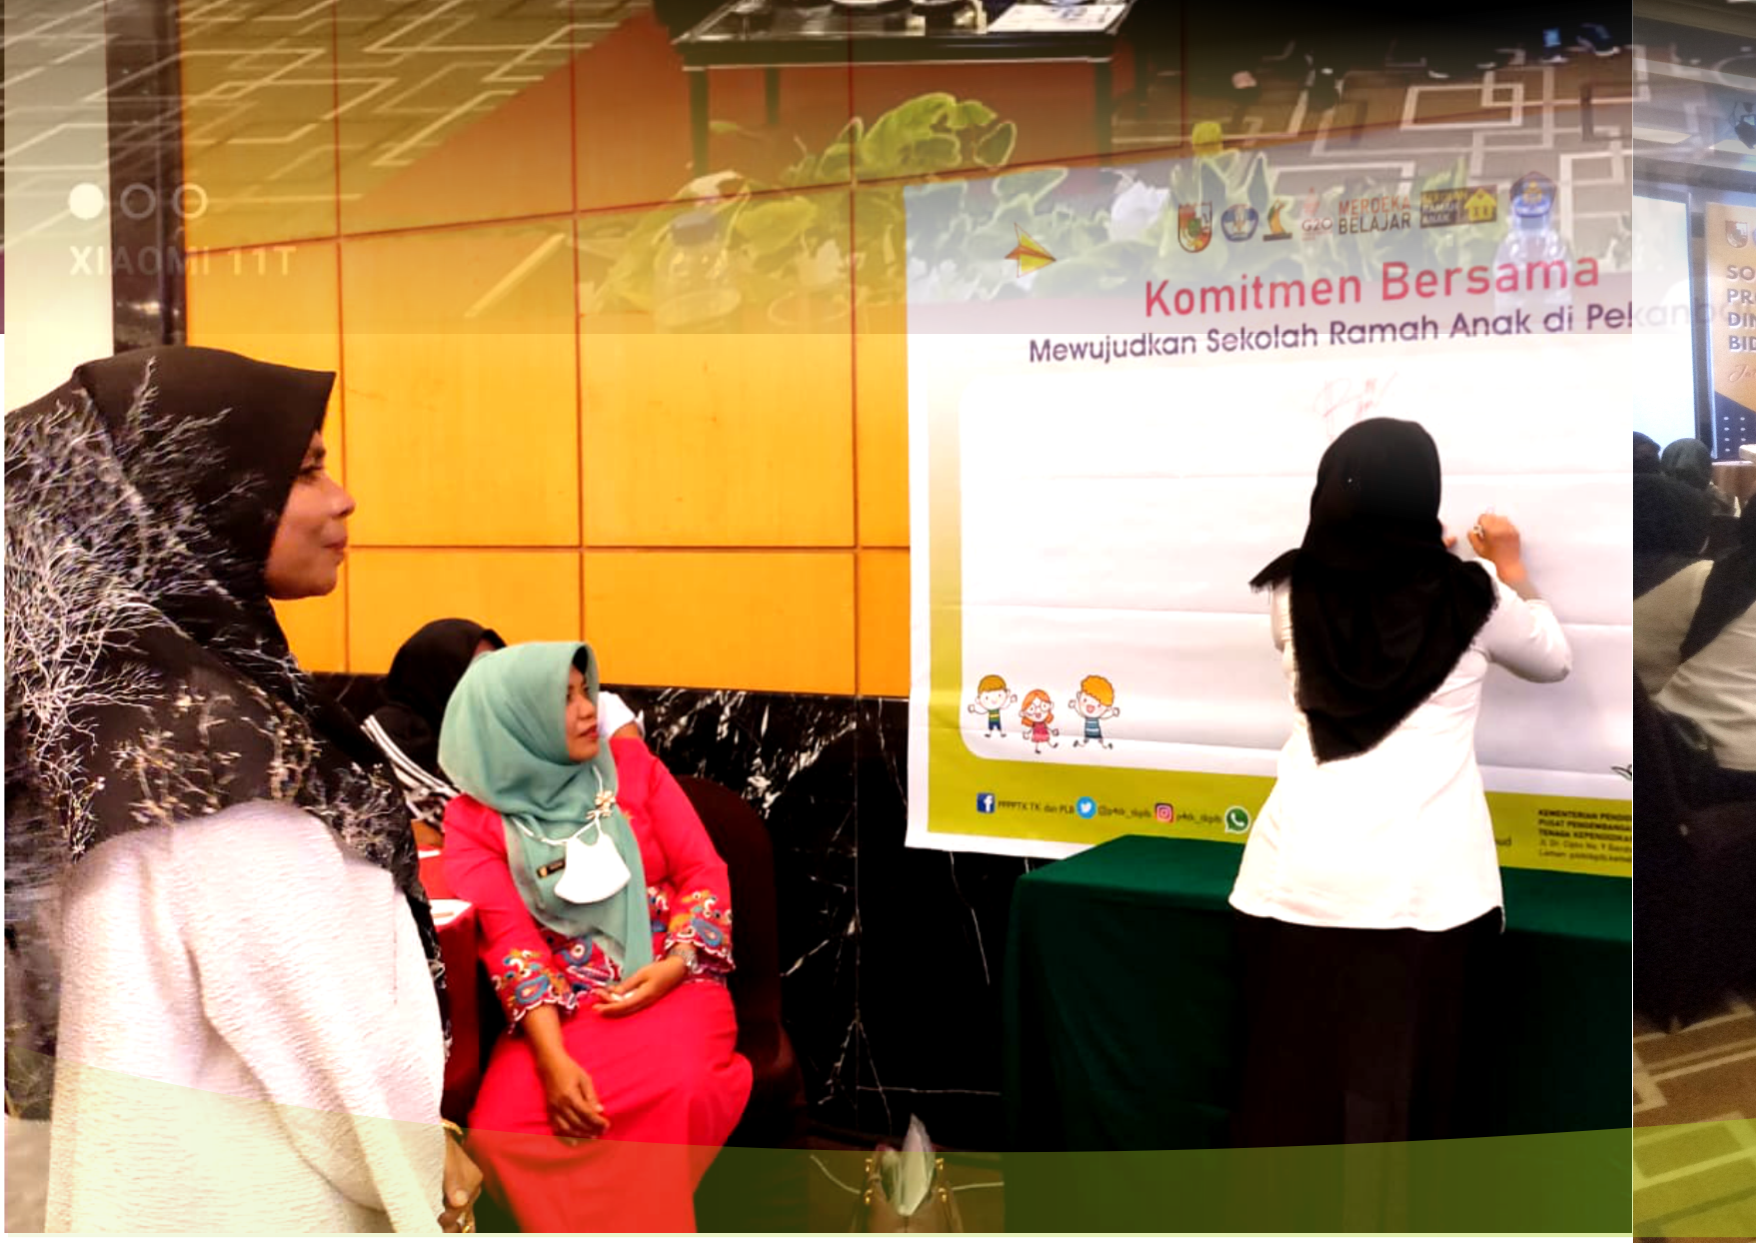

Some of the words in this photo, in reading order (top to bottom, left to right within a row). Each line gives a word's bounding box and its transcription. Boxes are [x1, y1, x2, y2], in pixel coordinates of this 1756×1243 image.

[1338, 195, 1411, 217] MERDEKA
[1301, 217, 1333, 233] G20
[1338, 213, 1411, 236] BELAJAR
[1146, 273, 1361, 318] Komitmen
[1381, 256, 1600, 302] Bersama
[1029, 333, 1198, 364] Mewujudkan
[1206, 323, 1318, 353] Sekolah
[1330, 315, 1439, 346] Ramah
[1450, 310, 1532, 339] Anak
[1543, 305, 1573, 332] di
